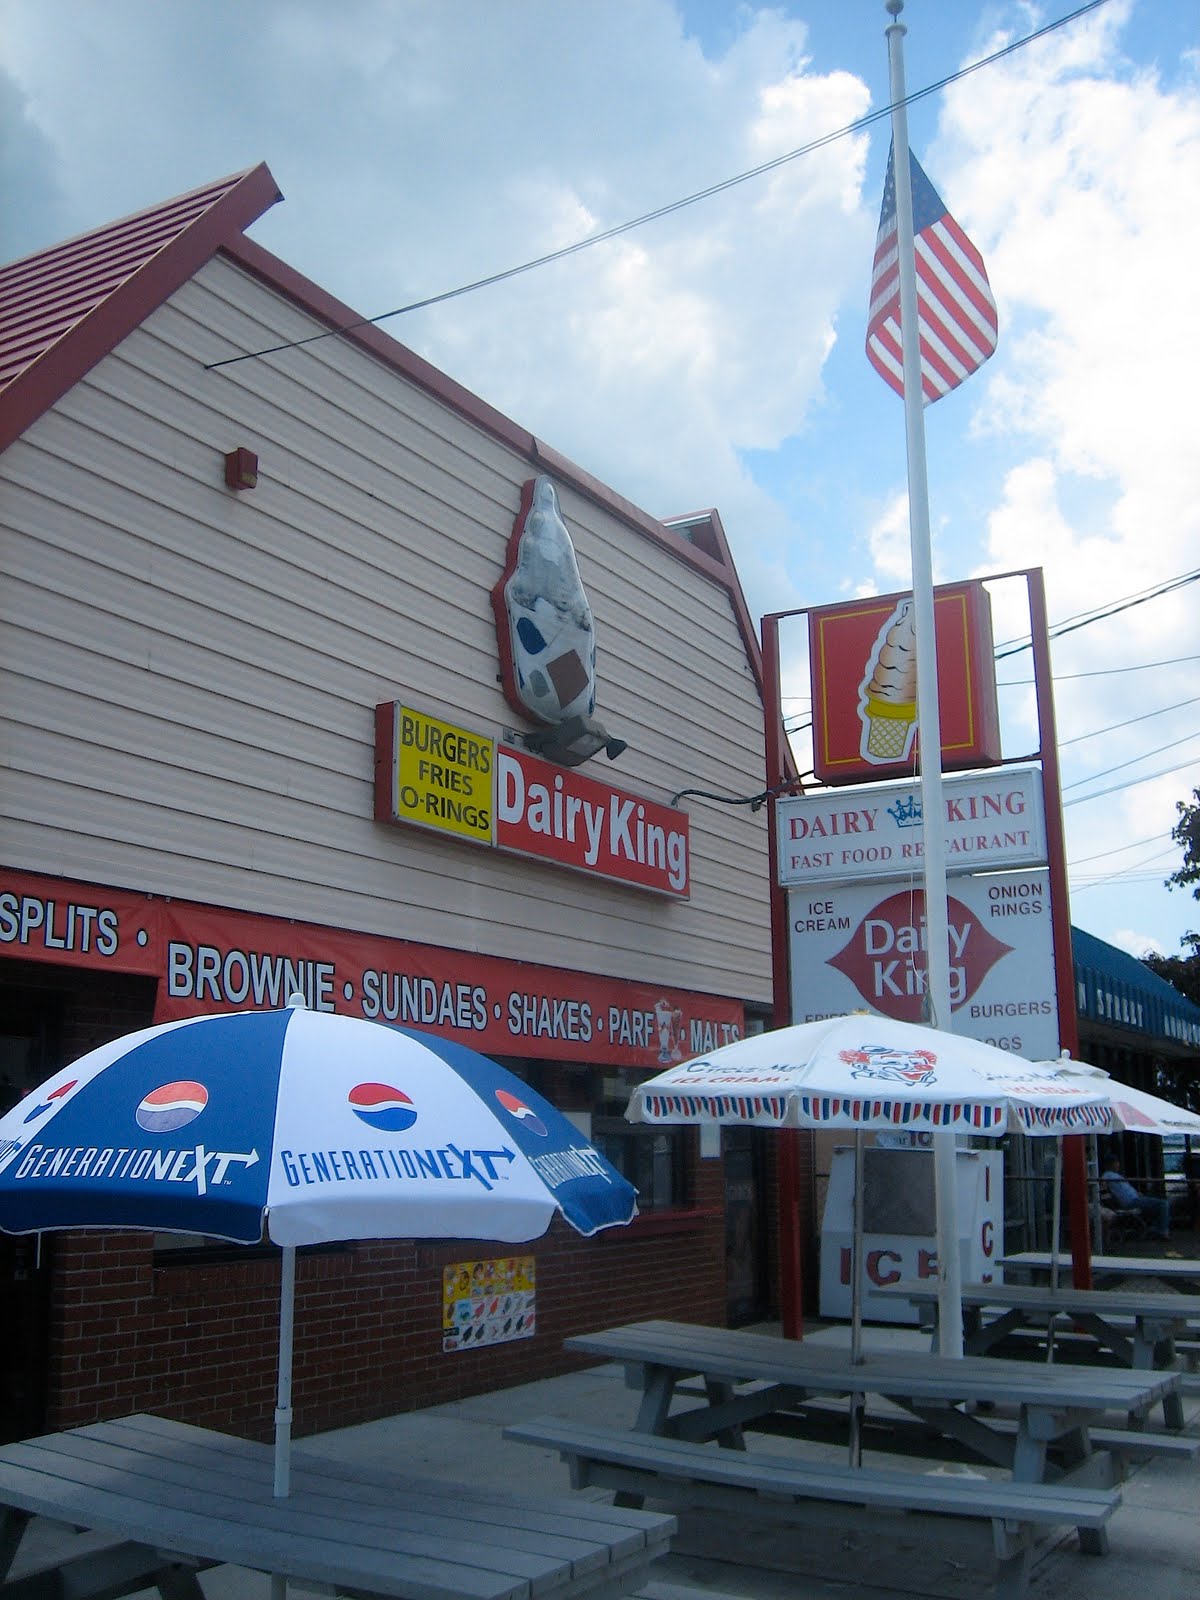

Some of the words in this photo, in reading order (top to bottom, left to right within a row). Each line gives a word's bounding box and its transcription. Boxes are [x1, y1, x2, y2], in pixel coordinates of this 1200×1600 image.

[402, 716, 490, 773] BURGERS
[419, 760, 473, 796] FRIES
[400, 786, 490, 831] O-RINGS
[498, 753, 604, 866] Dairy
[609, 795, 686, 890] King
[789, 809, 878, 840] DAIRY
[946, 791, 1026, 822] KING
[791, 852, 833, 869] FAST
[842, 846, 892, 864] FOOD
[902, 831, 1029, 858] REAURANT
[809, 902, 834, 915] ICE
[988, 883, 1042, 900] ONION
[990, 900, 1043, 917] RINGS
[0, 893, 118, 956] SPLITS
[795, 917, 850, 933] CREAM
[865, 916, 972, 958] Daiy
[168, 942, 335, 1011] BROWNIE
[362, 969, 488, 1031] SUNDAES
[507, 992, 592, 1042] SHAKES
[971, 1002, 1051, 1018] BURGERS
[977, 1037, 1022, 1050] OGS
